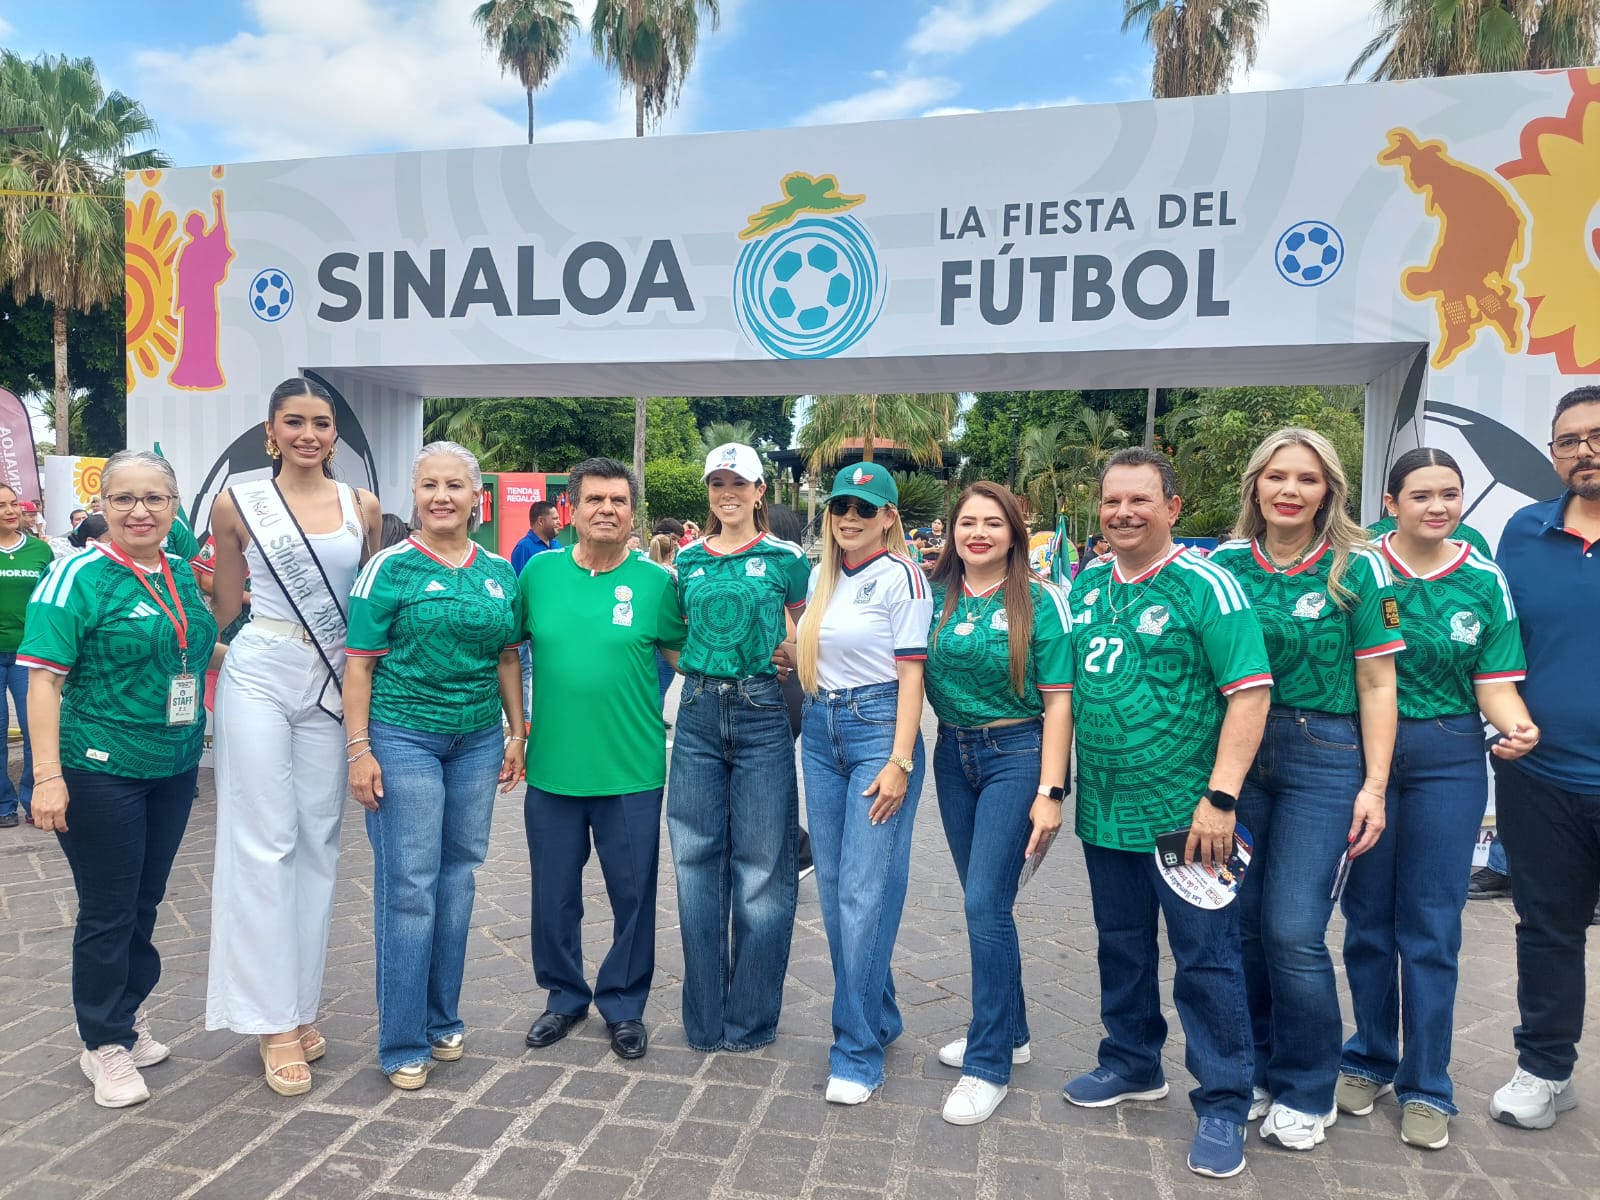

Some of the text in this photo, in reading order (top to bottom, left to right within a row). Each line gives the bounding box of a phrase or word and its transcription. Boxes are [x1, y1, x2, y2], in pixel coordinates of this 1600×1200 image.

[940, 190, 1237, 240] LA FIESTA DEL
[317, 239, 696, 322] SINALOA
[940, 243, 1230, 326] FÚTBOL
[506, 487, 533, 495] TIENDA
[270, 534, 313, 600] Sinaloa
[1084, 636, 1124, 674] 27
[172, 696, 193, 706] STAFF
